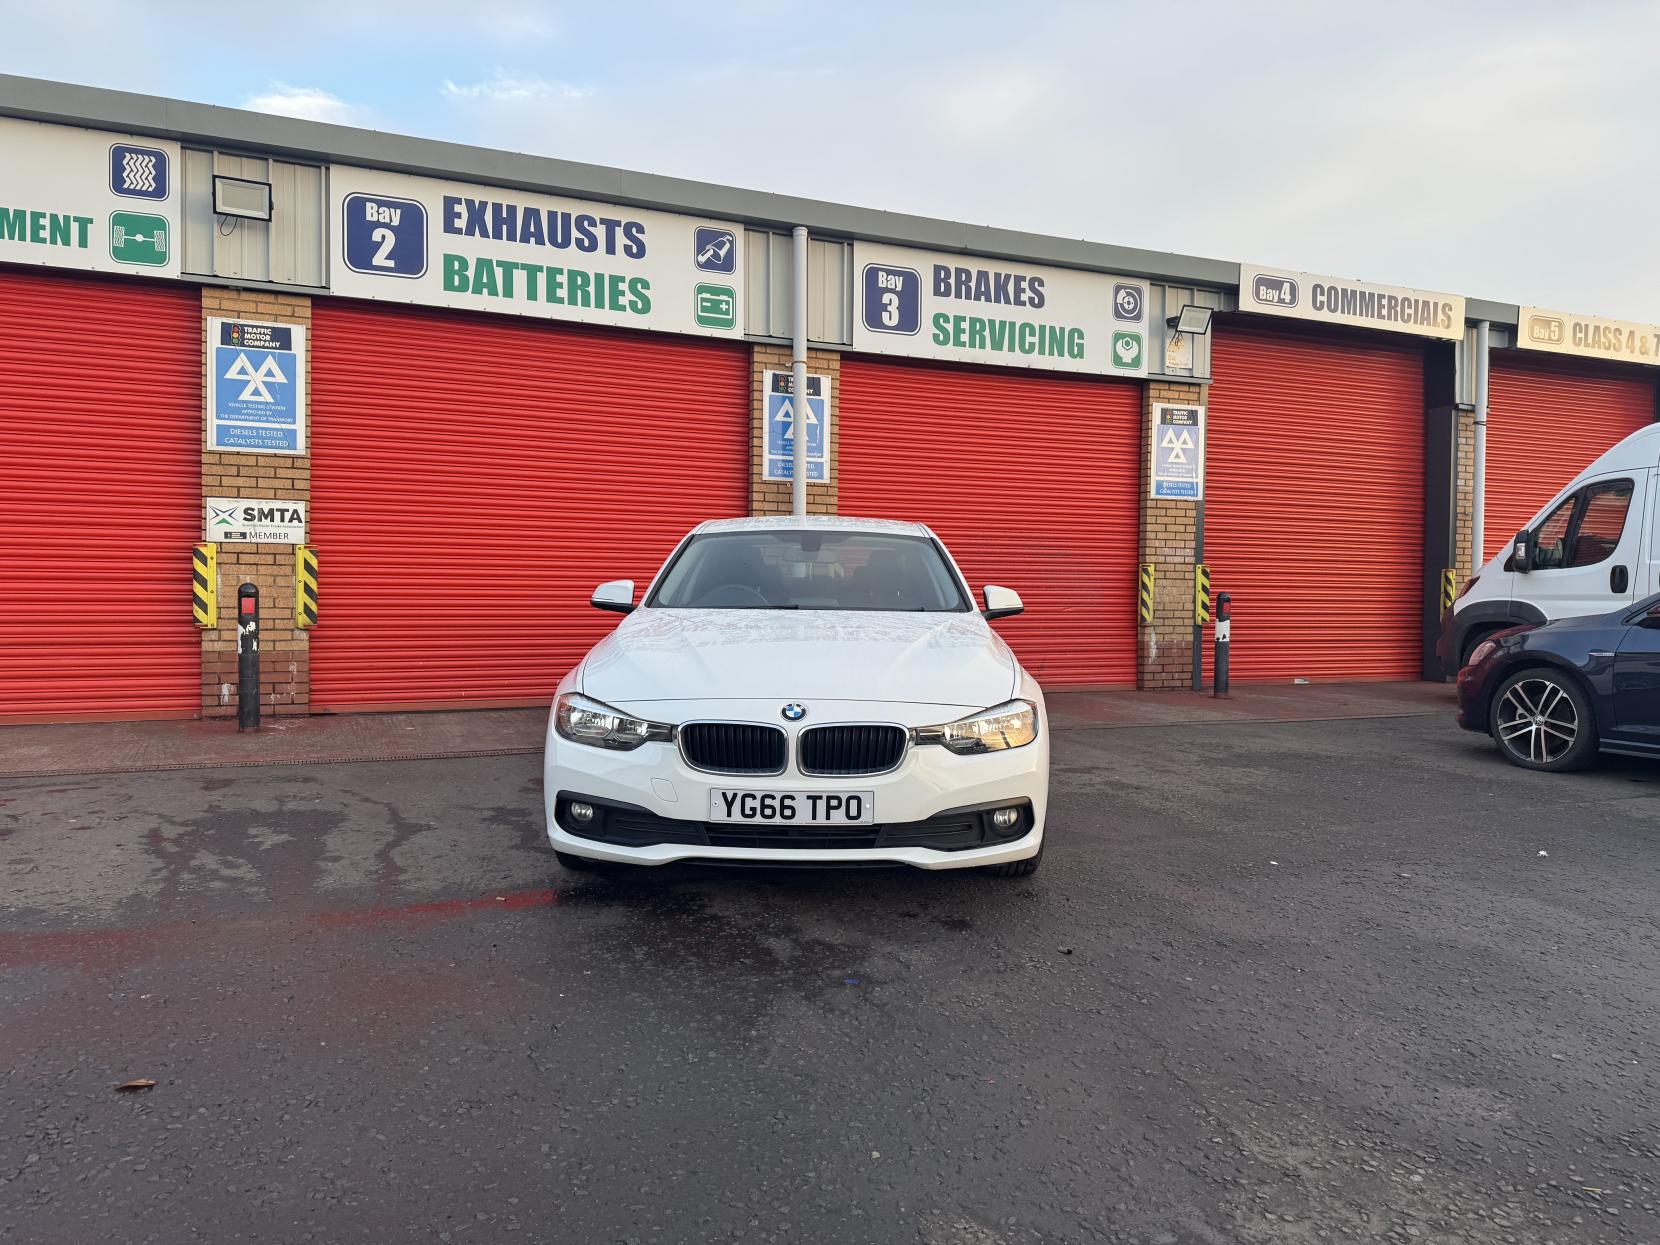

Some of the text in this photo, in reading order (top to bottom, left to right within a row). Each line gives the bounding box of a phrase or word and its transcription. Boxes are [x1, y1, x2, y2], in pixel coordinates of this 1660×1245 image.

[365, 201, 401, 226] Bay
[0, 207, 94, 248] MENT
[442, 195, 646, 260] EXHAUSTS
[372, 227, 396, 268] 2
[442, 253, 652, 315] BATTERIES
[878, 270, 904, 291] Bay
[932, 263, 1045, 310] BRAKES
[1259, 282, 1291, 303] Bay 4
[881, 292, 899, 327] 3
[1311, 283, 1453, 330] COMMERCIALS
[244, 326, 272, 334] TRAFFIC
[244, 333, 271, 341] MOTOR
[932, 312, 1085, 360] SERVICING
[1534, 321, 1559, 340] Bay 5
[1572, 322, 1623, 352] CLASS
[1625, 330, 1635, 354] 4
[1639, 335, 1650, 356] &
[244, 339, 280, 348] COMPANY
[224, 437, 289, 447] CATALYSTS TESTED
[230, 428, 257, 436] DIESELS
[242, 507, 303, 523] SMTA
[249, 531, 289, 540] MEMBER
[721, 791, 862, 821] YG66 TPO
